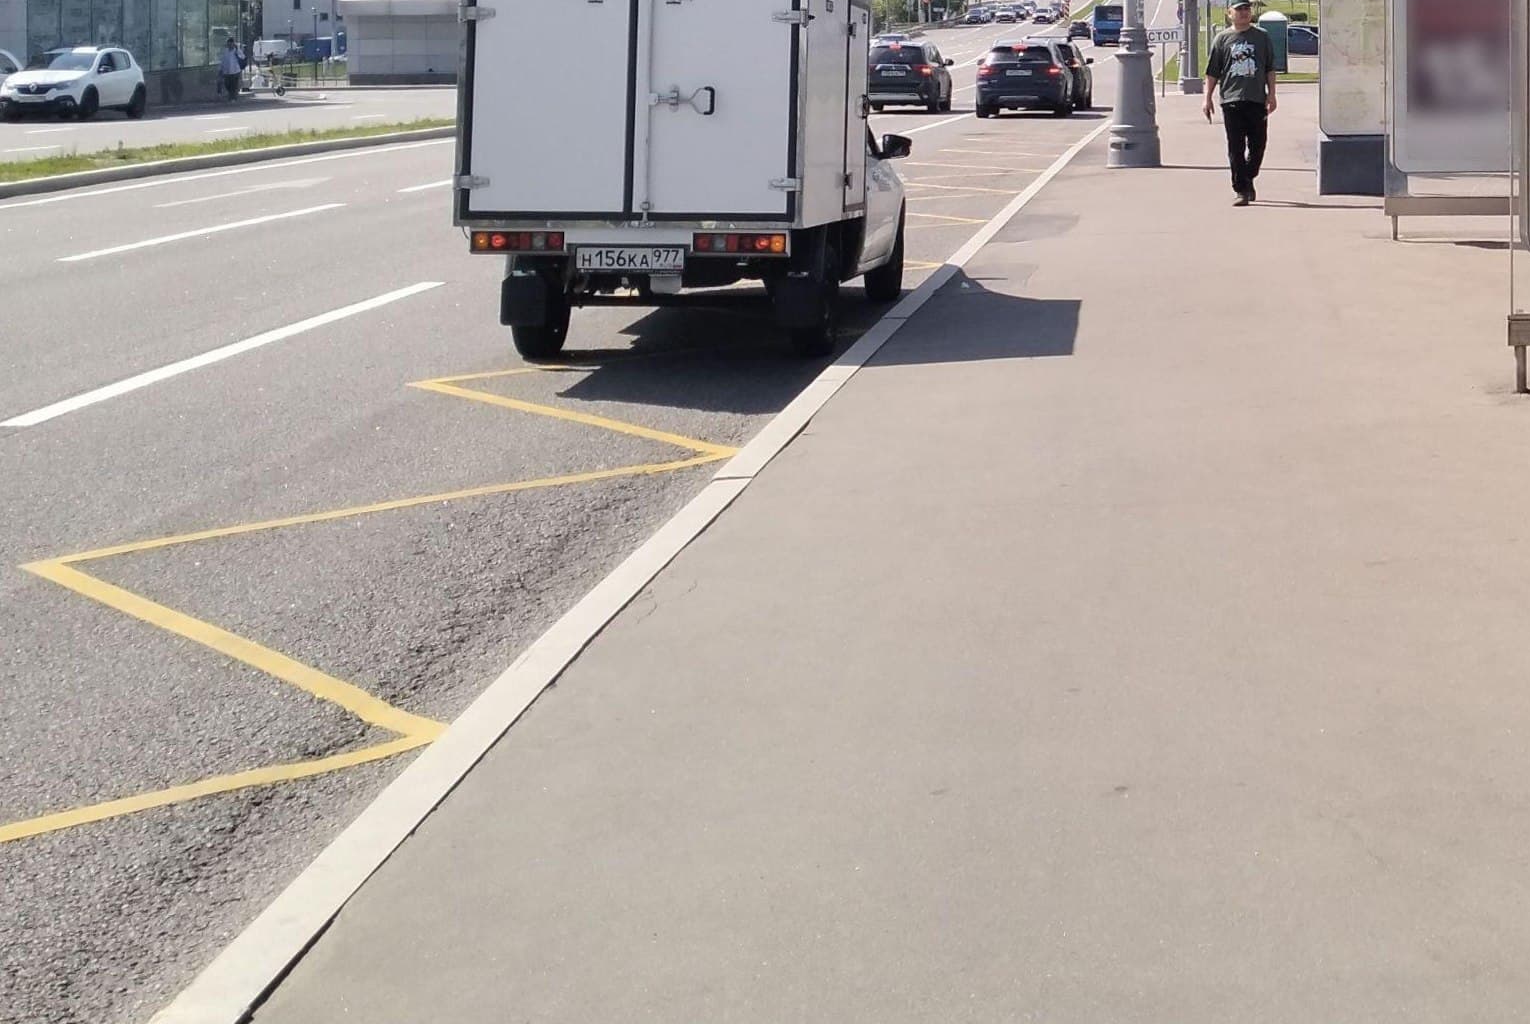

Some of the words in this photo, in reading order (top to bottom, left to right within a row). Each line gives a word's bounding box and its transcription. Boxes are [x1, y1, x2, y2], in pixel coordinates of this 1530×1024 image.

[1148, 31, 1179, 42] СТОП
[582, 250, 649, 267] Н156КА
[653, 249, 680, 263] 977
